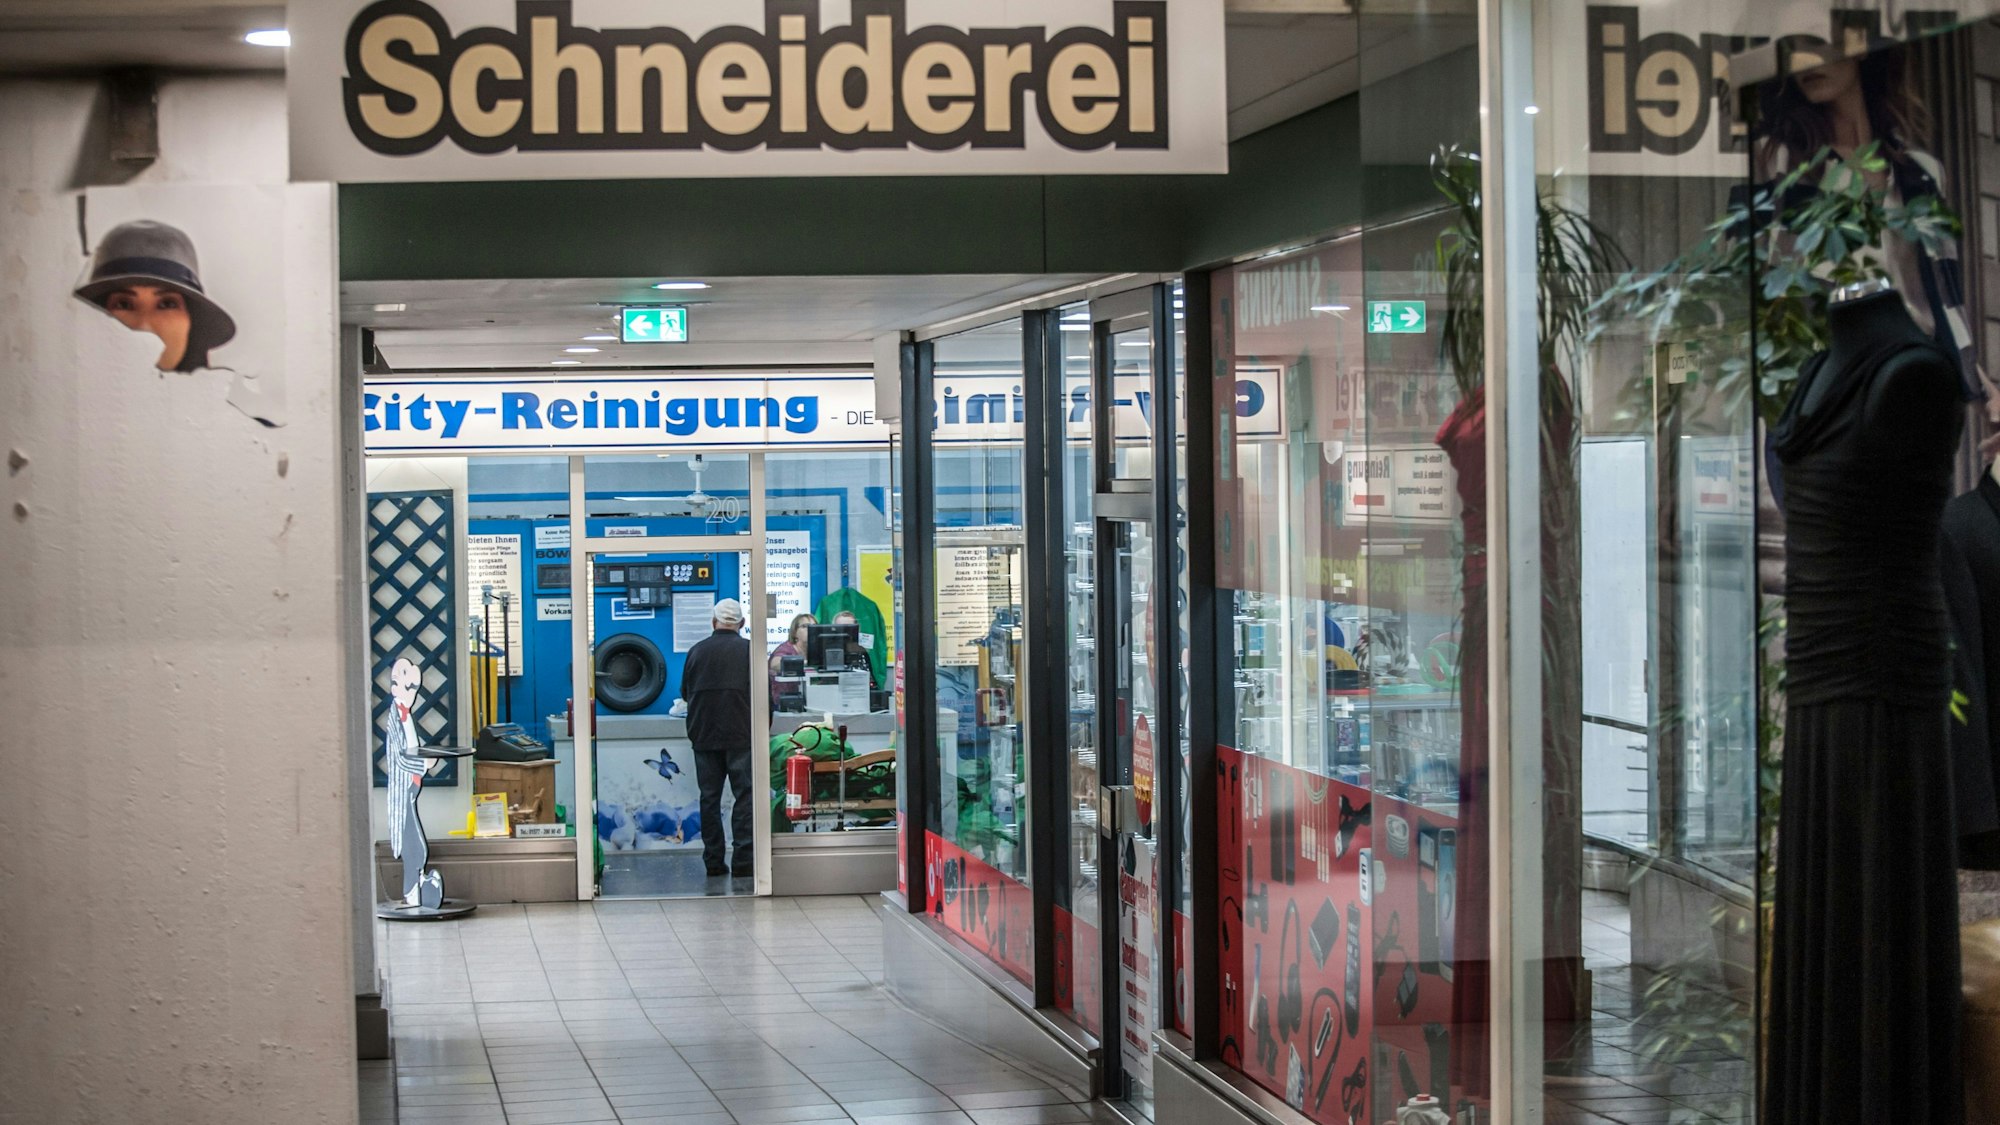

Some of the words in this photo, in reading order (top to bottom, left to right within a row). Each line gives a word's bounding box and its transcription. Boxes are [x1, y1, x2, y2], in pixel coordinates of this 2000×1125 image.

[344, 0, 1168, 155] Schneiderei
[847, 411, 874, 425] DIE
[705, 497, 741, 523] 20
